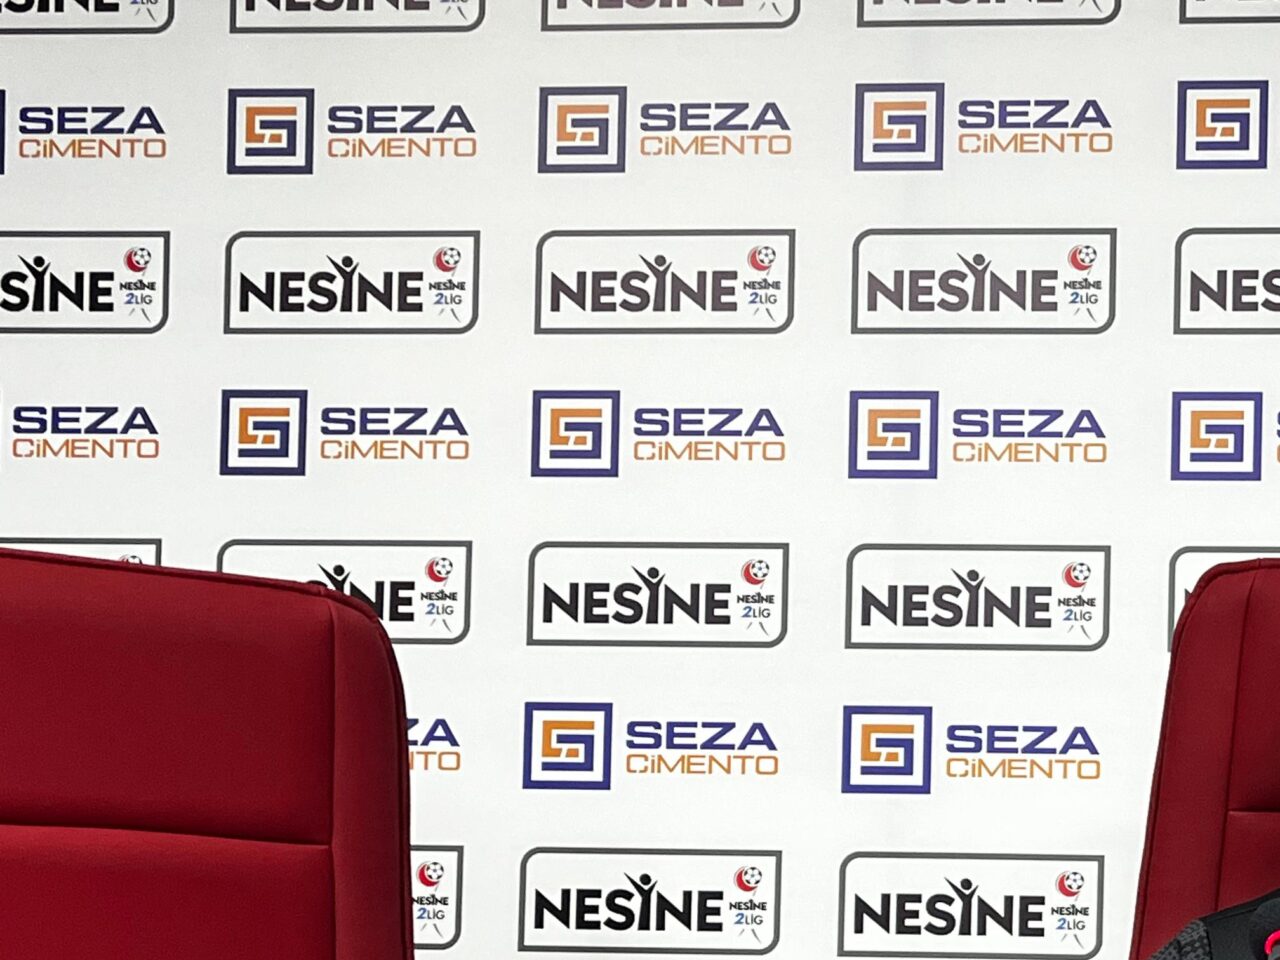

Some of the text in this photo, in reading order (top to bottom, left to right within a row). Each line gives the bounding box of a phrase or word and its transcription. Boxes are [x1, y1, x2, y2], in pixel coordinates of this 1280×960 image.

[20, 107, 162, 134] SEZA
[328, 106, 474, 133] SEZA
[641, 103, 790, 131] SEZA
[958, 100, 1110, 128] SEZA
[13, 406, 158, 434] SEZA
[321, 408, 468, 435] SEZA
[634, 408, 783, 436] SEZA
[953, 409, 1105, 438] SEZA
[626, 721, 777, 751] SEZA
[946, 725, 1099, 755] SEZA
